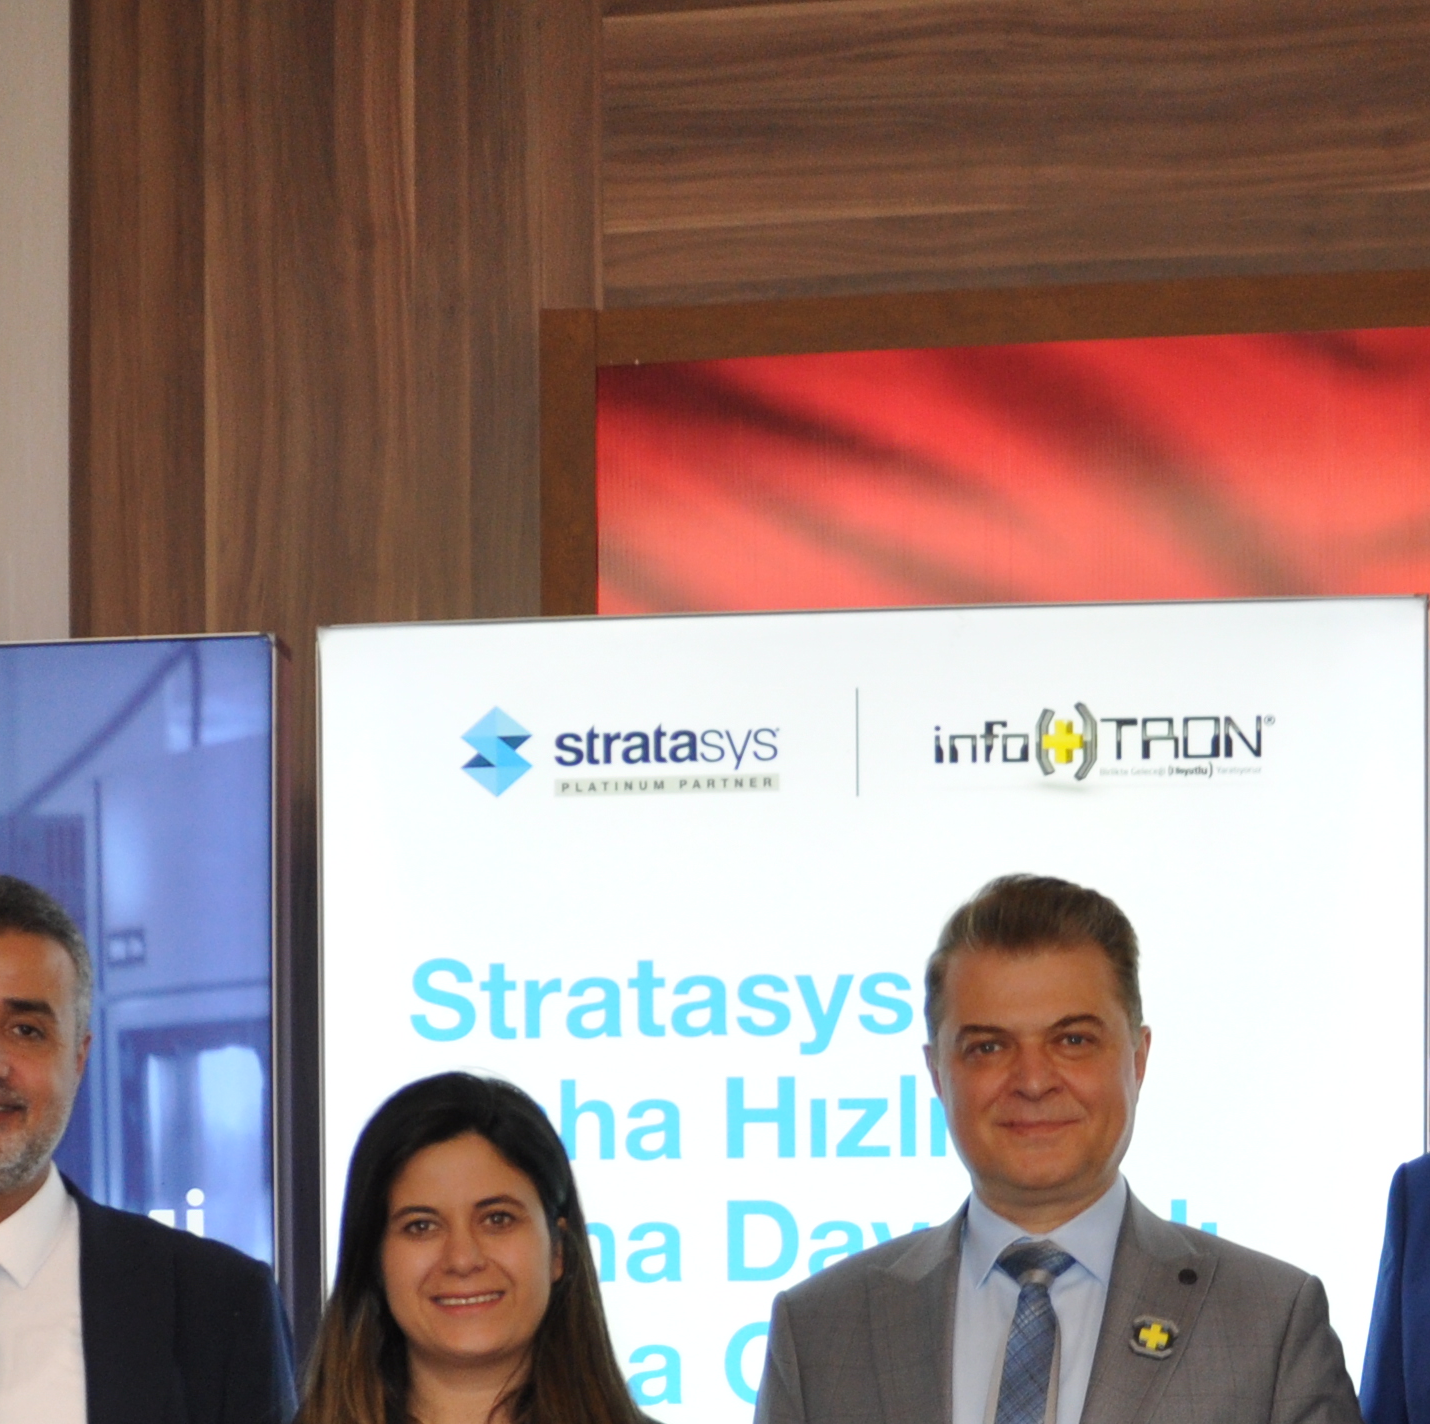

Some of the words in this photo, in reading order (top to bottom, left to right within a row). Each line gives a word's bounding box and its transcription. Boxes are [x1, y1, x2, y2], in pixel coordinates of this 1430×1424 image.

[553, 722, 779, 771] stratasys
[561, 779, 665, 793] PLATINUM
[679, 777, 773, 790] PARTNER
